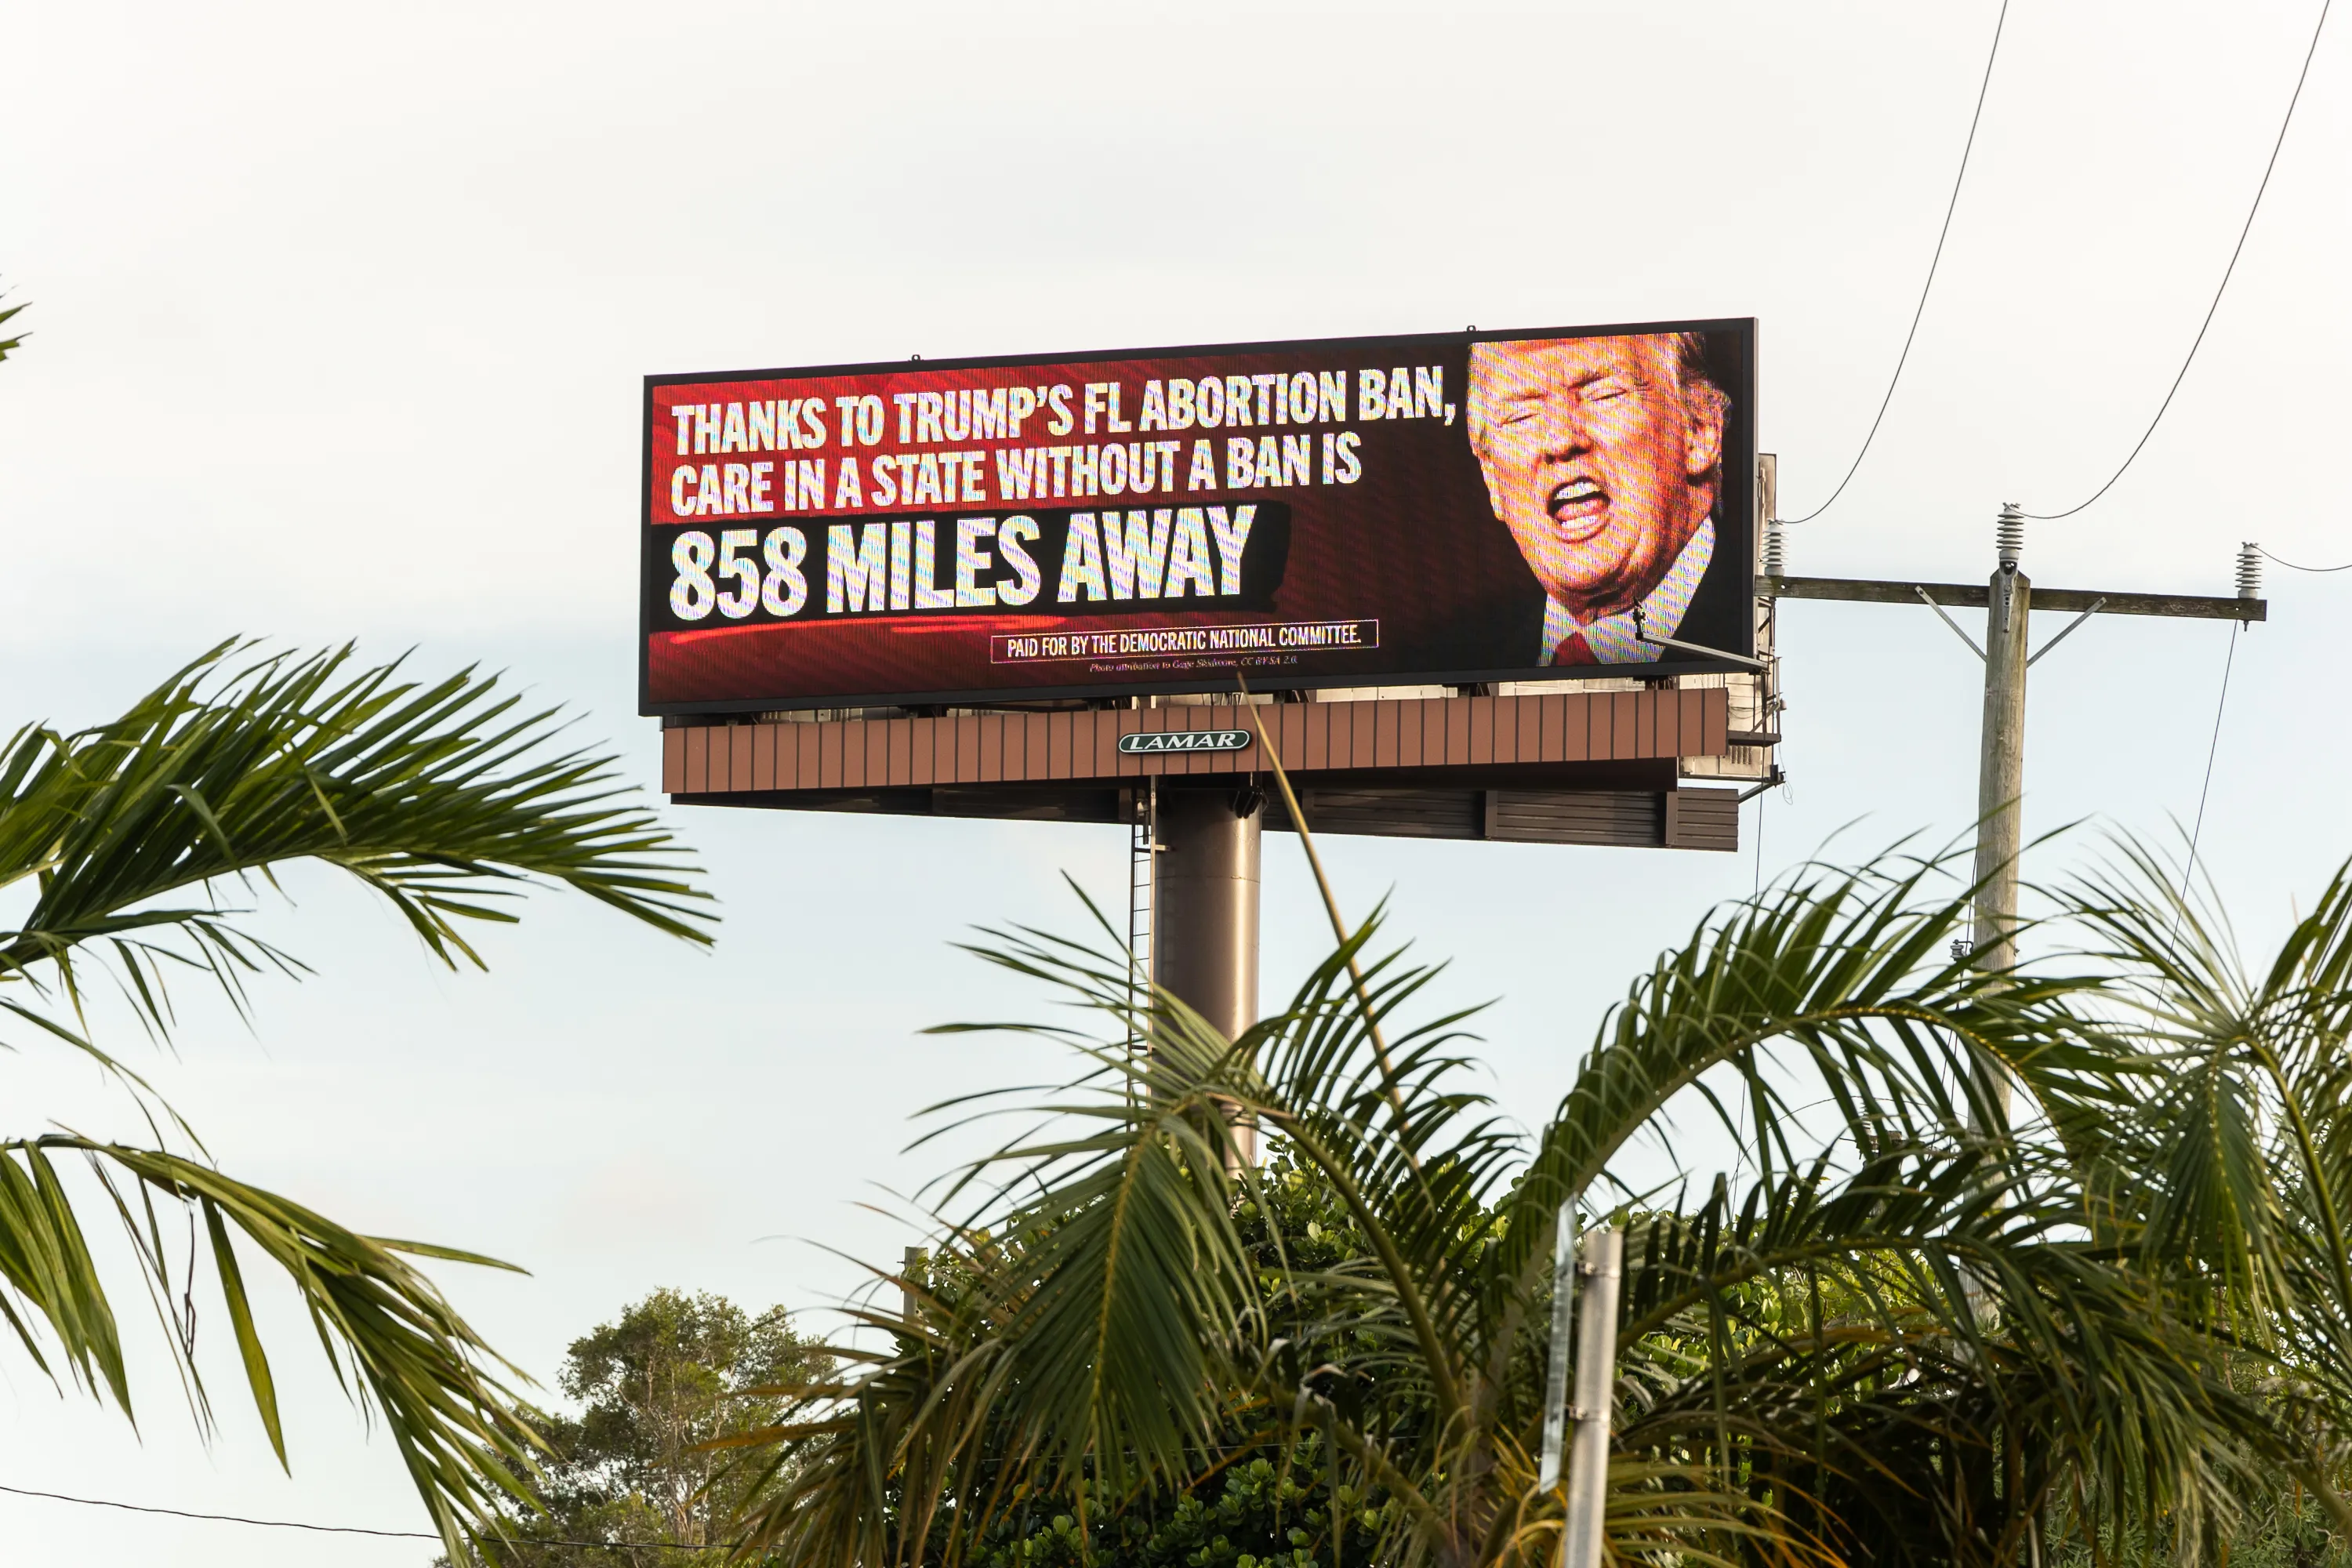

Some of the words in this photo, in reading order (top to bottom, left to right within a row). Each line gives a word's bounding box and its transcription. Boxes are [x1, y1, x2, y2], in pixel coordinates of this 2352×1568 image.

[671, 397, 826, 456] THANKS
[836, 395, 884, 447] TO
[893, 384, 1074, 444] TRUMP'S
[1084, 382, 1131, 434] FL
[1140, 371, 1346, 431] ABORTION
[1359, 365, 1456, 426] BAN,
[671, 461, 773, 517] CARE
[785, 459, 825, 511] IN
[834, 457, 862, 509] A
[871, 451, 986, 506] STATE
[996, 441, 1180, 500] WITHOUT
[1188, 439, 1217, 491] A
[1228, 434, 1311, 488] BAN
[1323, 431, 1362, 484] IS
[670, 526, 808, 621] 858
[826, 515, 1040, 613] MILES
[1058, 504, 1257, 602] AWAY
[1007, 638, 1038, 657] PAID
[1042, 637, 1067, 656] FOR
[1071, 636, 1089, 655] BY
[1091, 635, 1116, 654] THE
[1120, 630, 1206, 653] DEMOCRATIC
[1210, 627, 1276, 649] NATIONAL
[1090, 663, 1114, 673] Photo
[1240, 657, 1254, 666] CC
[1129, 733, 1237, 750] LAMAR
